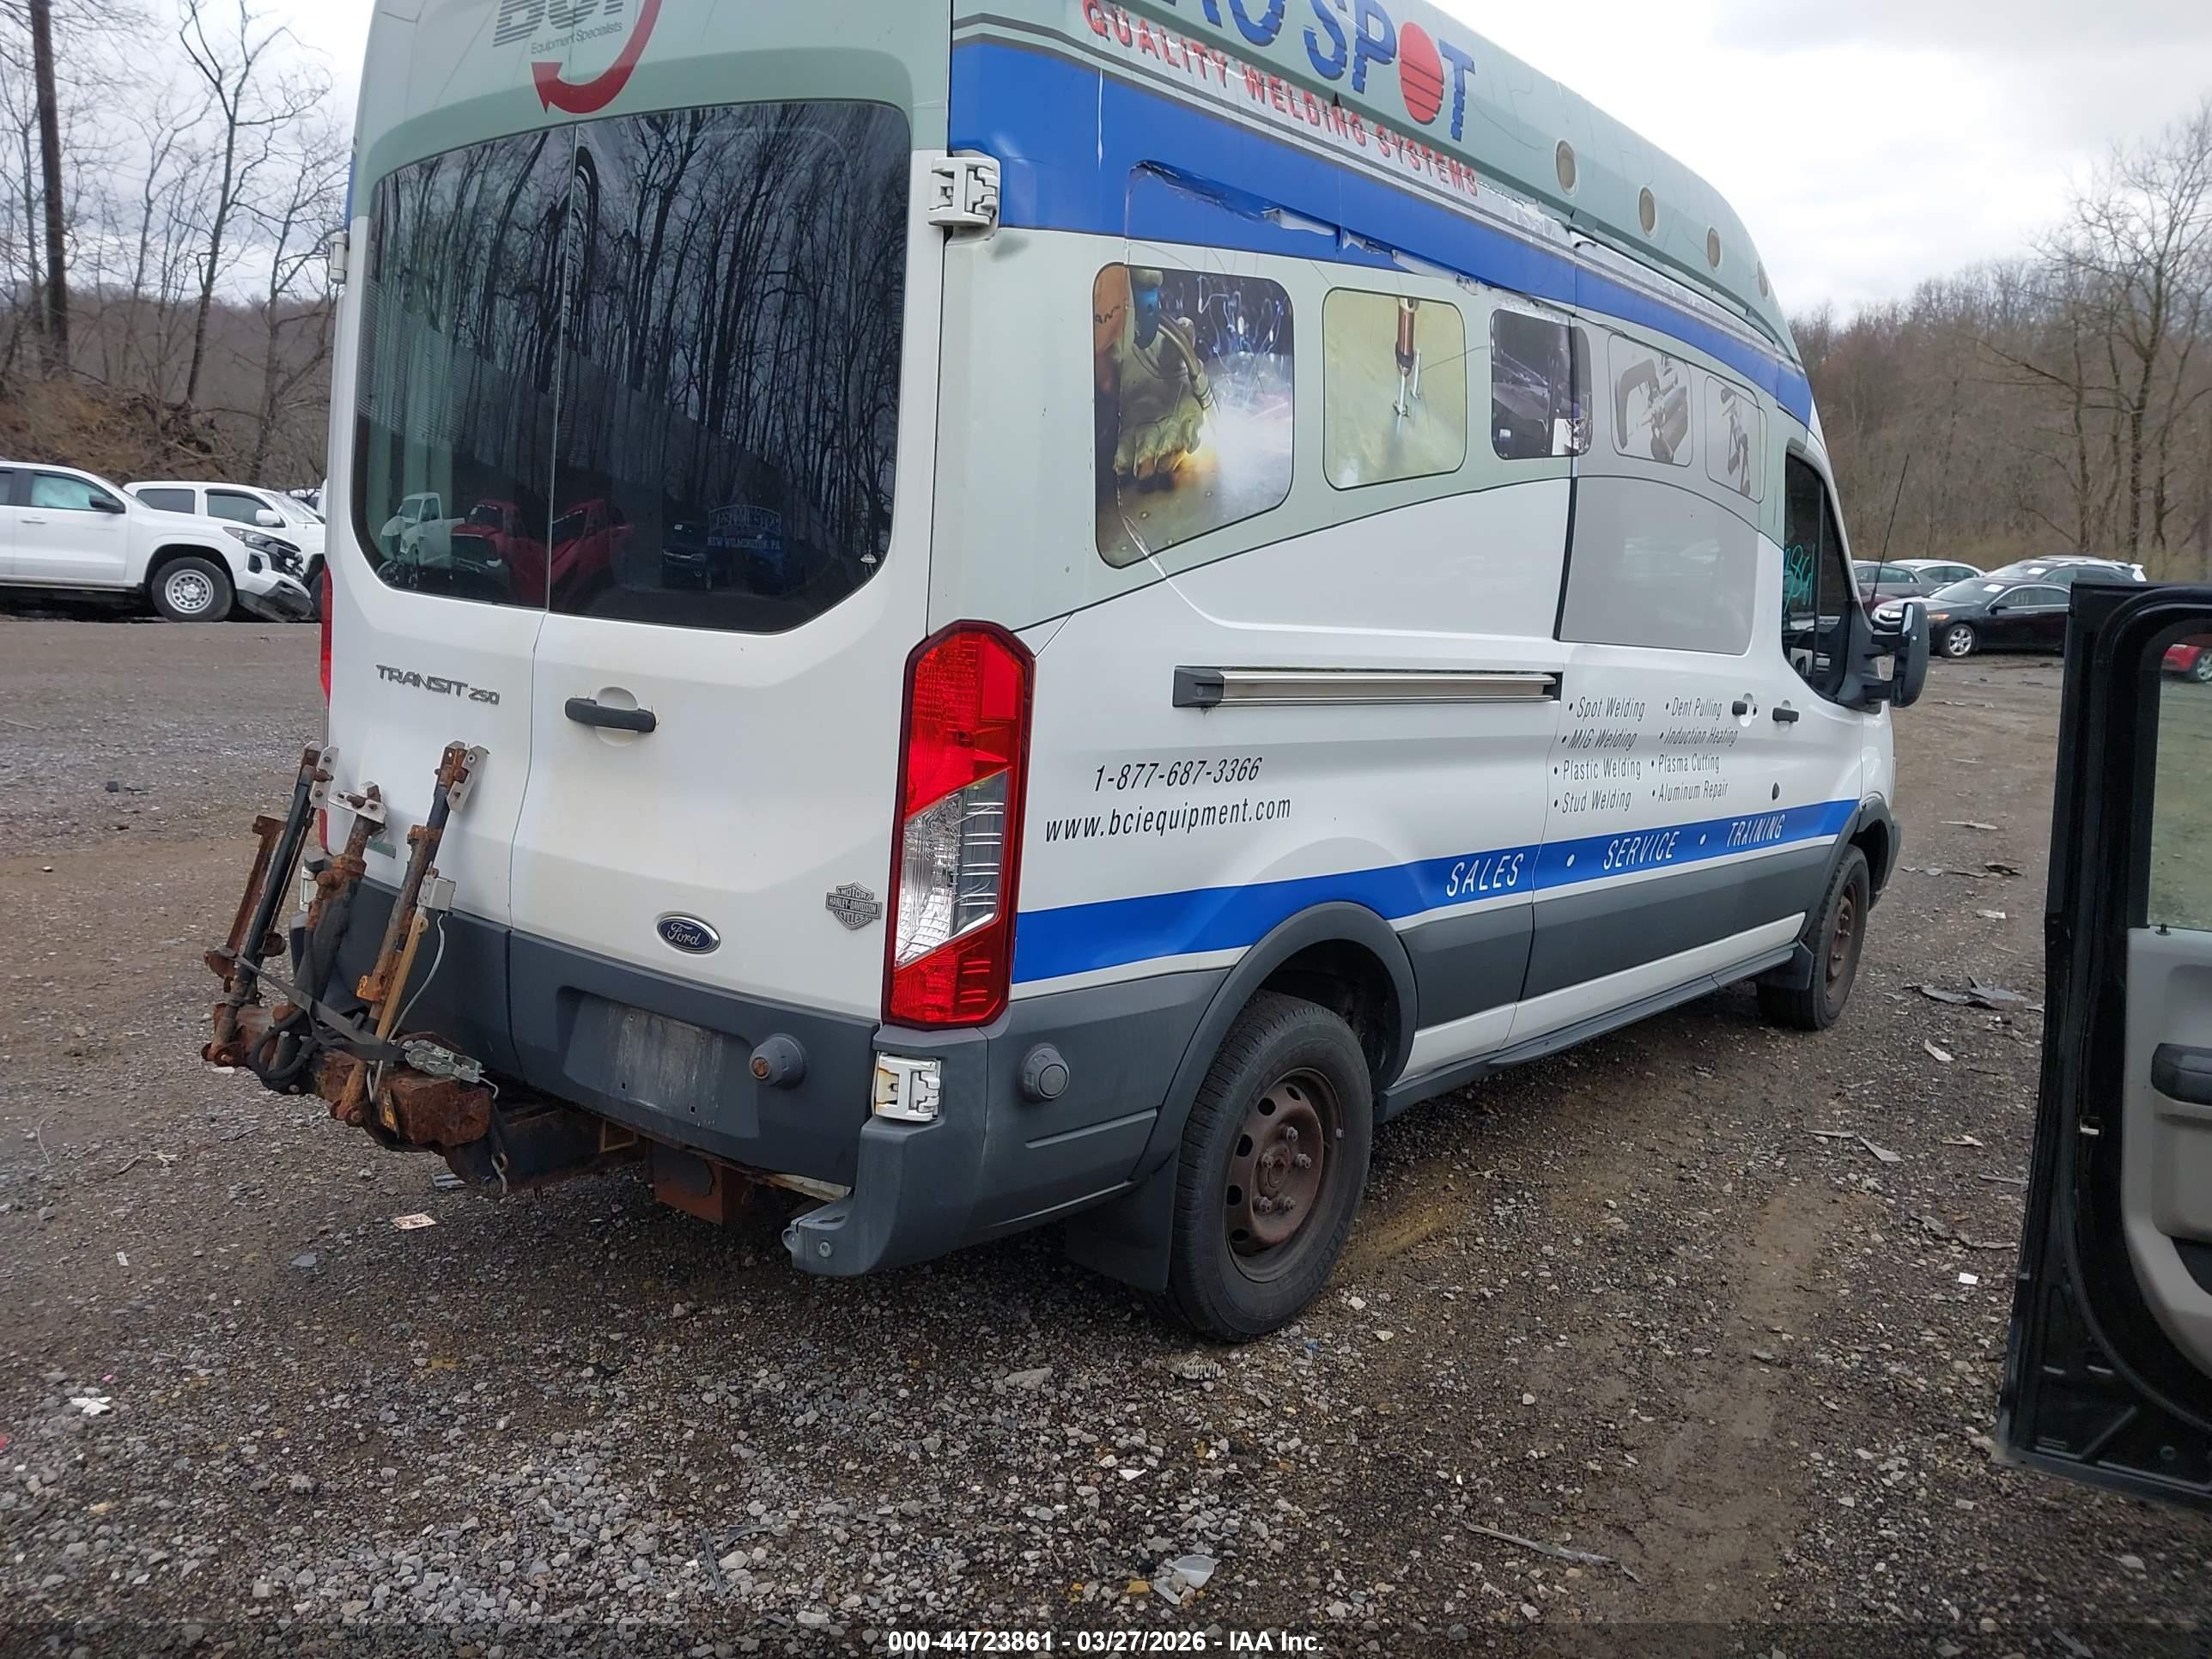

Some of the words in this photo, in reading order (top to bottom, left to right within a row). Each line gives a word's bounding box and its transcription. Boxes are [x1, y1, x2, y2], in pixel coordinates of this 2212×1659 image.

[531, 33, 575, 54] Equipment
[575, 21, 623, 45] Specialists
[1303, 0, 1475, 143] SPOT
[1083, 0, 1228, 88] QUALITY
[1241, 63, 1367, 147] WELDING
[1375, 124, 1478, 197] SYSTEMS
[375, 664, 468, 697] TRANSIT
[468, 687, 501, 705] 250
[1577, 696, 1603, 721] Spot
[1605, 697, 1645, 721] Welding
[1671, 697, 1692, 717] Dent
[1693, 697, 1723, 720] Pulling
[1567, 729, 1595, 750] MIG
[1595, 729, 1638, 751] Welding
[1664, 727, 1706, 745] Induction
[1707, 727, 1739, 747] Heating
[1095, 757, 1262, 792] 1-877-687-3366
[1563, 759, 1599, 781] Plastic
[1603, 757, 1641, 781] Welding
[1658, 754, 1689, 773] Plasma
[1692, 753, 1720, 774] Cutting
[1562, 790, 1588, 813] Stud
[1591, 788, 1632, 811] Welding
[1658, 782, 1701, 803] Aluminum
[1703, 779, 1729, 802] Repair
[1045, 798, 1291, 842] www.bciequipment.com
[1446, 853, 1523, 897] SALES
[1602, 831, 1680, 871] SERVICE
[1726, 813, 1786, 848] TRAINING
[829, 896, 877, 915] HARLEY-DAVIDSON
[841, 886, 866, 900] MOTOR
[838, 910, 866, 925] CYCLES
[667, 921, 702, 946] Ford
